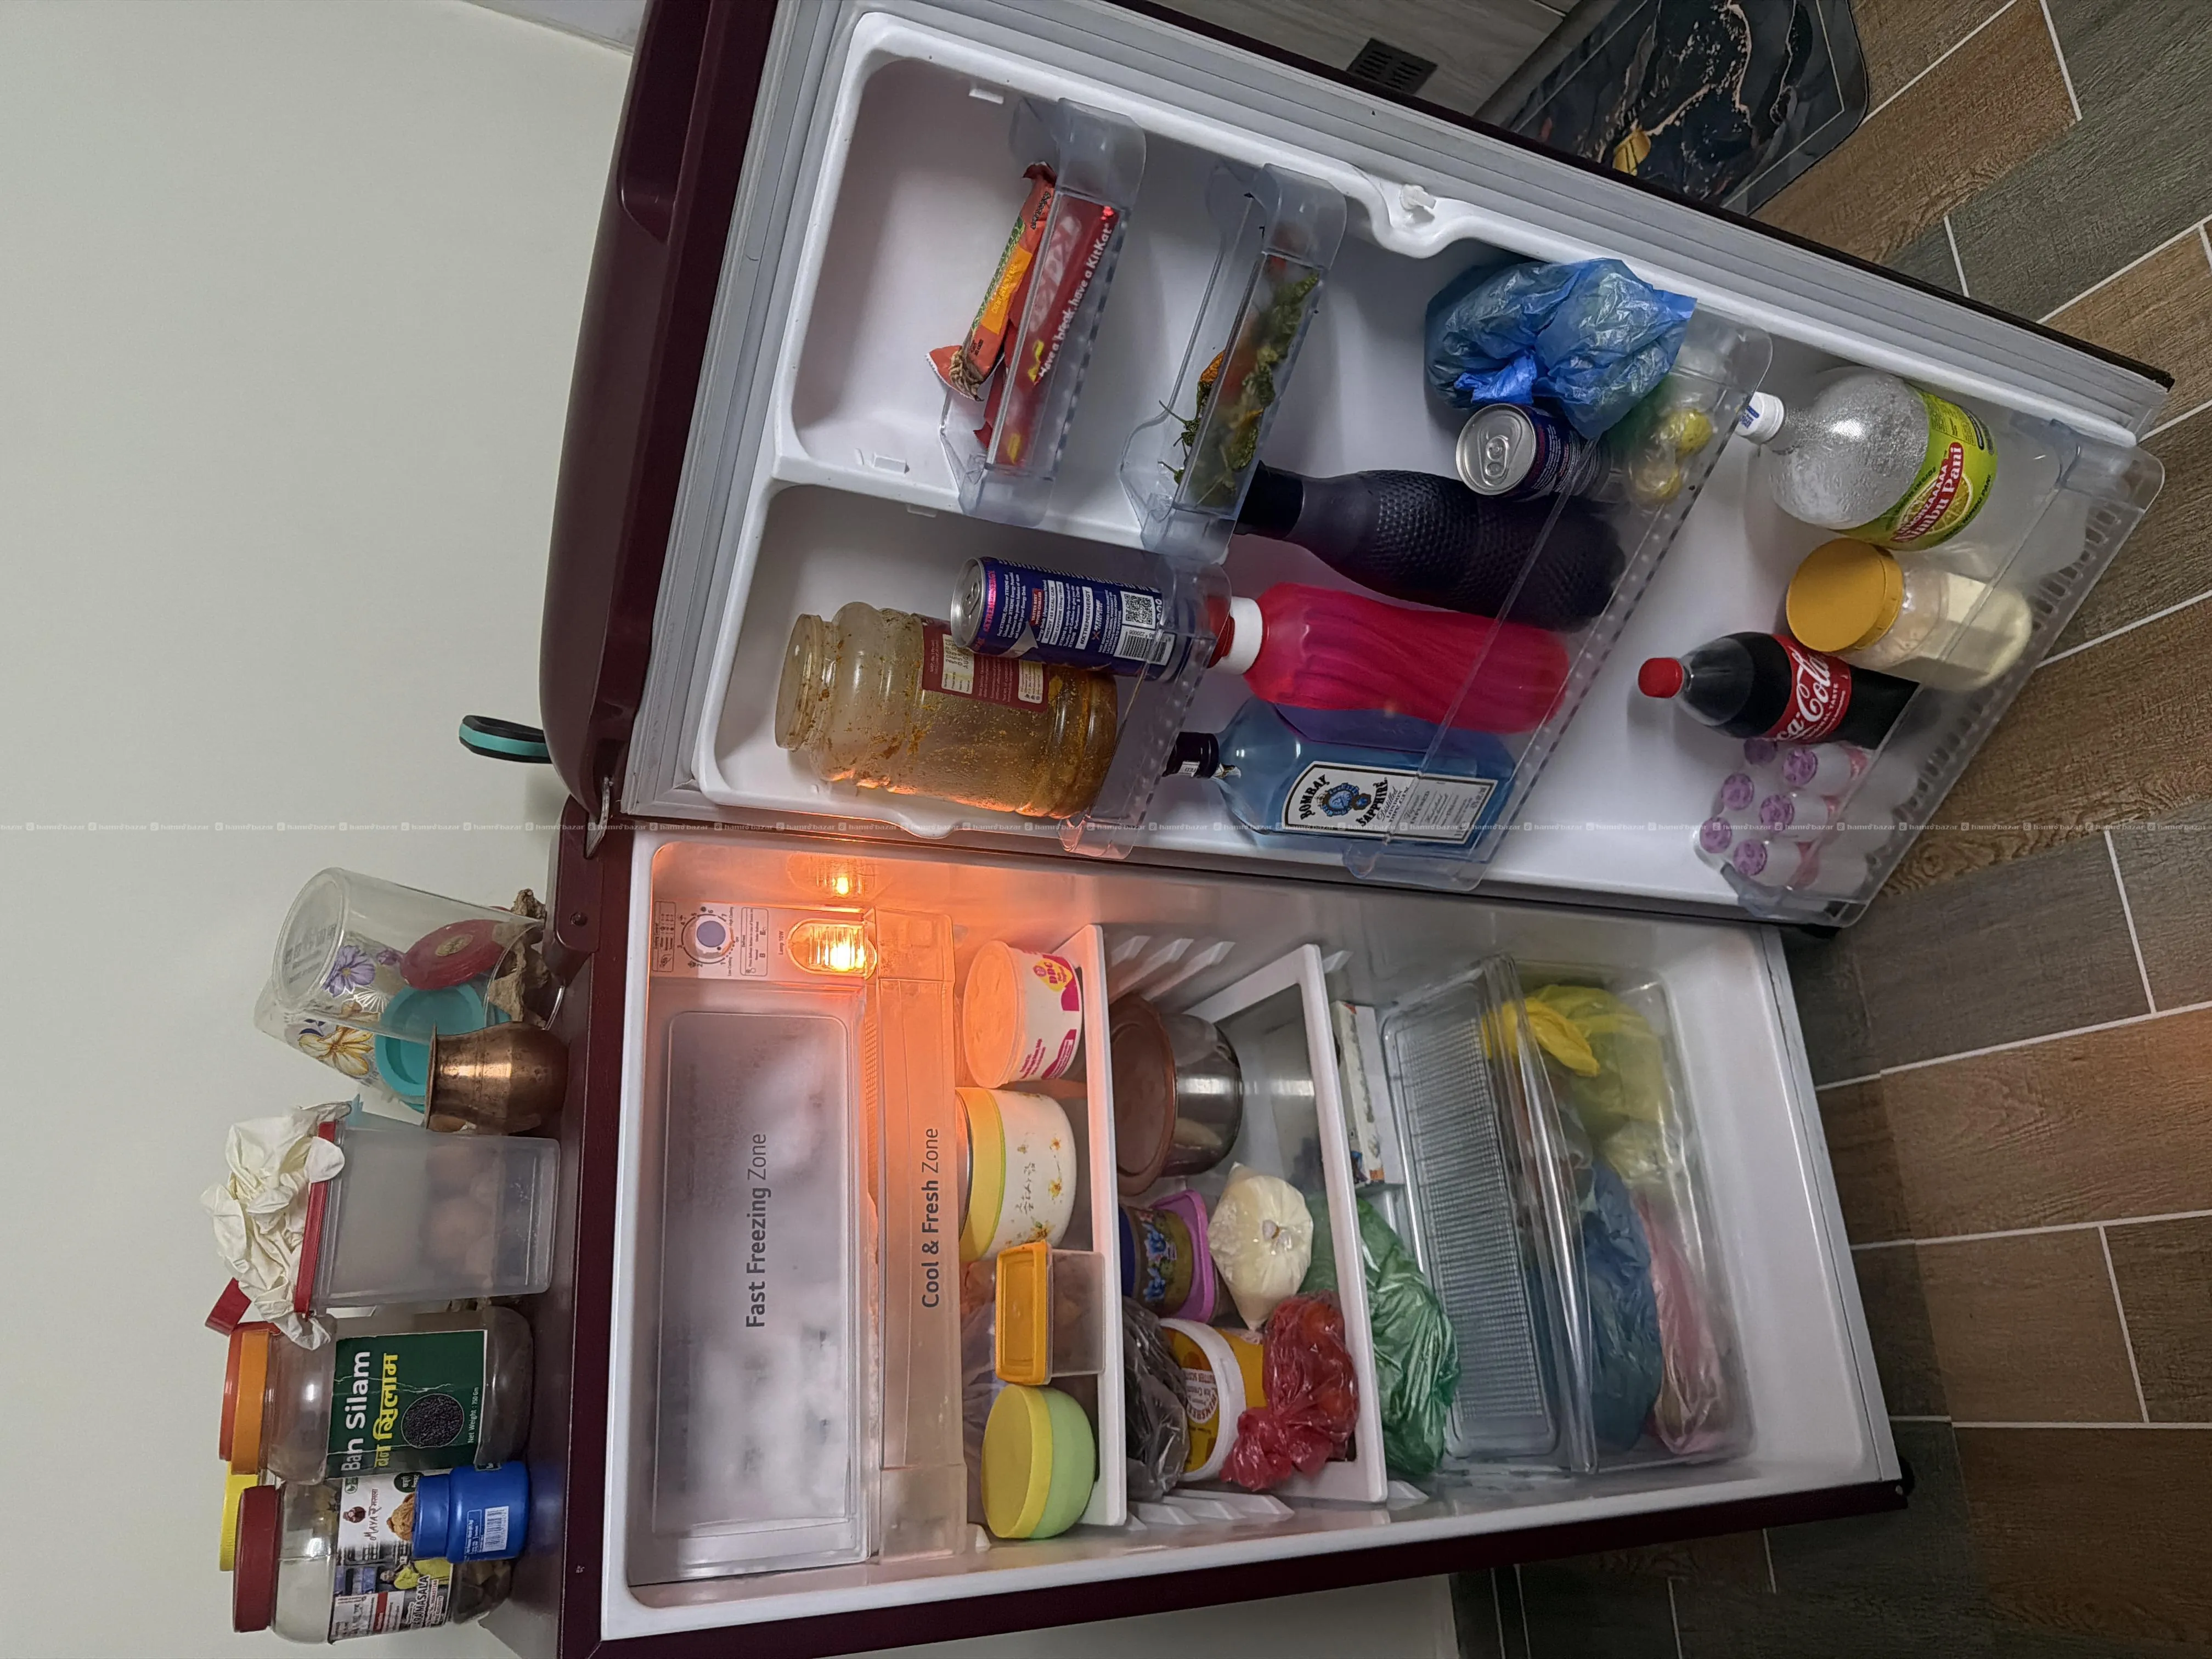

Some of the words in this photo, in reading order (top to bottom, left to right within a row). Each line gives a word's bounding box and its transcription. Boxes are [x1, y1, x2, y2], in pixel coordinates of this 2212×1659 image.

[1039, 351, 1056, 377] Have
[1052, 342, 1059, 351] a
[1068, 280, 1088, 306] have
[1085, 270, 1093, 279] a
[1942, 447, 1962, 492] Pani
[1008, 620, 1017, 638] Experience
[1080, 590, 1091, 644] #XTREMEENERGY
[1101, 614, 1109, 644] RECOMMENDED
[1068, 632, 1076, 648] XTREME
[1776, 646, 1831, 740] ca-Cola
[1830, 682, 1839, 708] TASTE
[1299, 774, 1330, 820] BOMBAY
[1356, 777, 1388, 826] SAPPHIRE
[1044, 962, 1058, 984] DDC
[747, 1134, 766, 1181] Zone
[922, 1128, 939, 1173] Zone
[922, 1181, 939, 1233] Fresh
[747, 1188, 771, 1274] Freezing
[922, 1240, 939, 1255] &
[922, 1261, 939, 1307] Cool
[746, 1293, 765, 1327] Fast
[345, 1352, 370, 1429] Silam
[472, 1387, 478, 1396] Gm
[468, 1410, 477, 1431] Weight
[341, 1438, 363, 1471] Ban
[374, 1444, 391, 1467] बन
